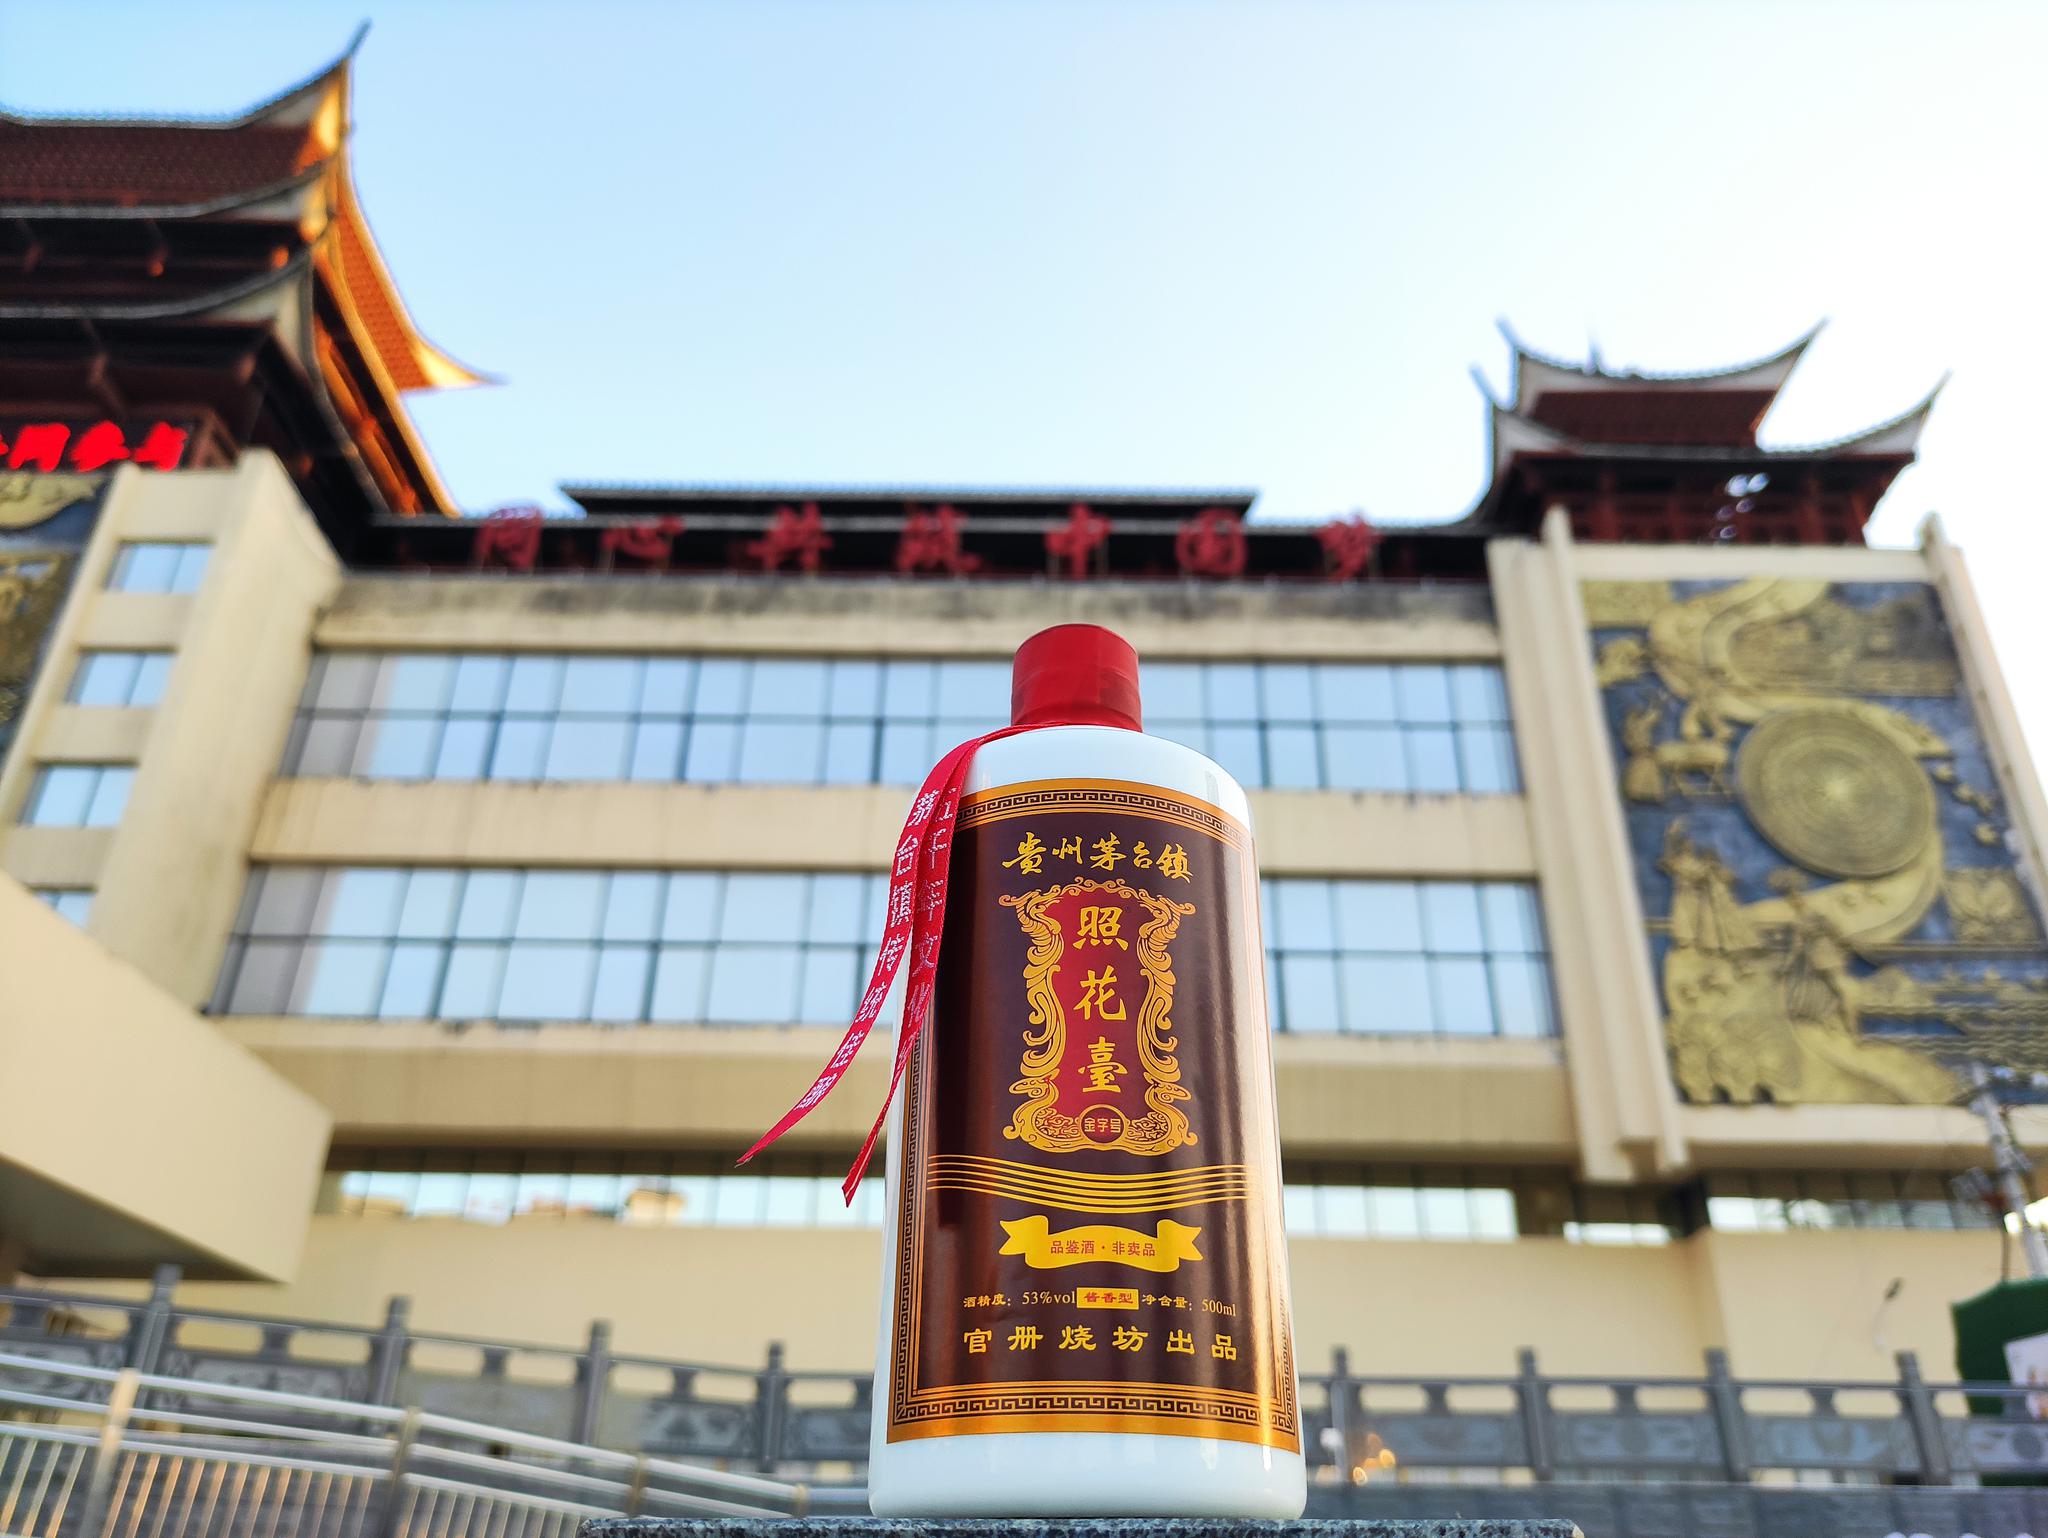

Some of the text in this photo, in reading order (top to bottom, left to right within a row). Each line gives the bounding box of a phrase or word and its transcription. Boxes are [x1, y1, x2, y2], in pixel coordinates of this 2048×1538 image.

[1001, 831, 1194, 884] 贵州茅台镇
[1072, 905, 1129, 1094] 照花臺
[1084, 1117, 1121, 1133] 金字号
[1021, 1290, 1076, 1305] 53%vol
[1084, 1291, 1134, 1304] 酱香型
[1201, 1299, 1237, 1317] 500ml
[963, 1325, 1237, 1360] 官册烧坊出品
